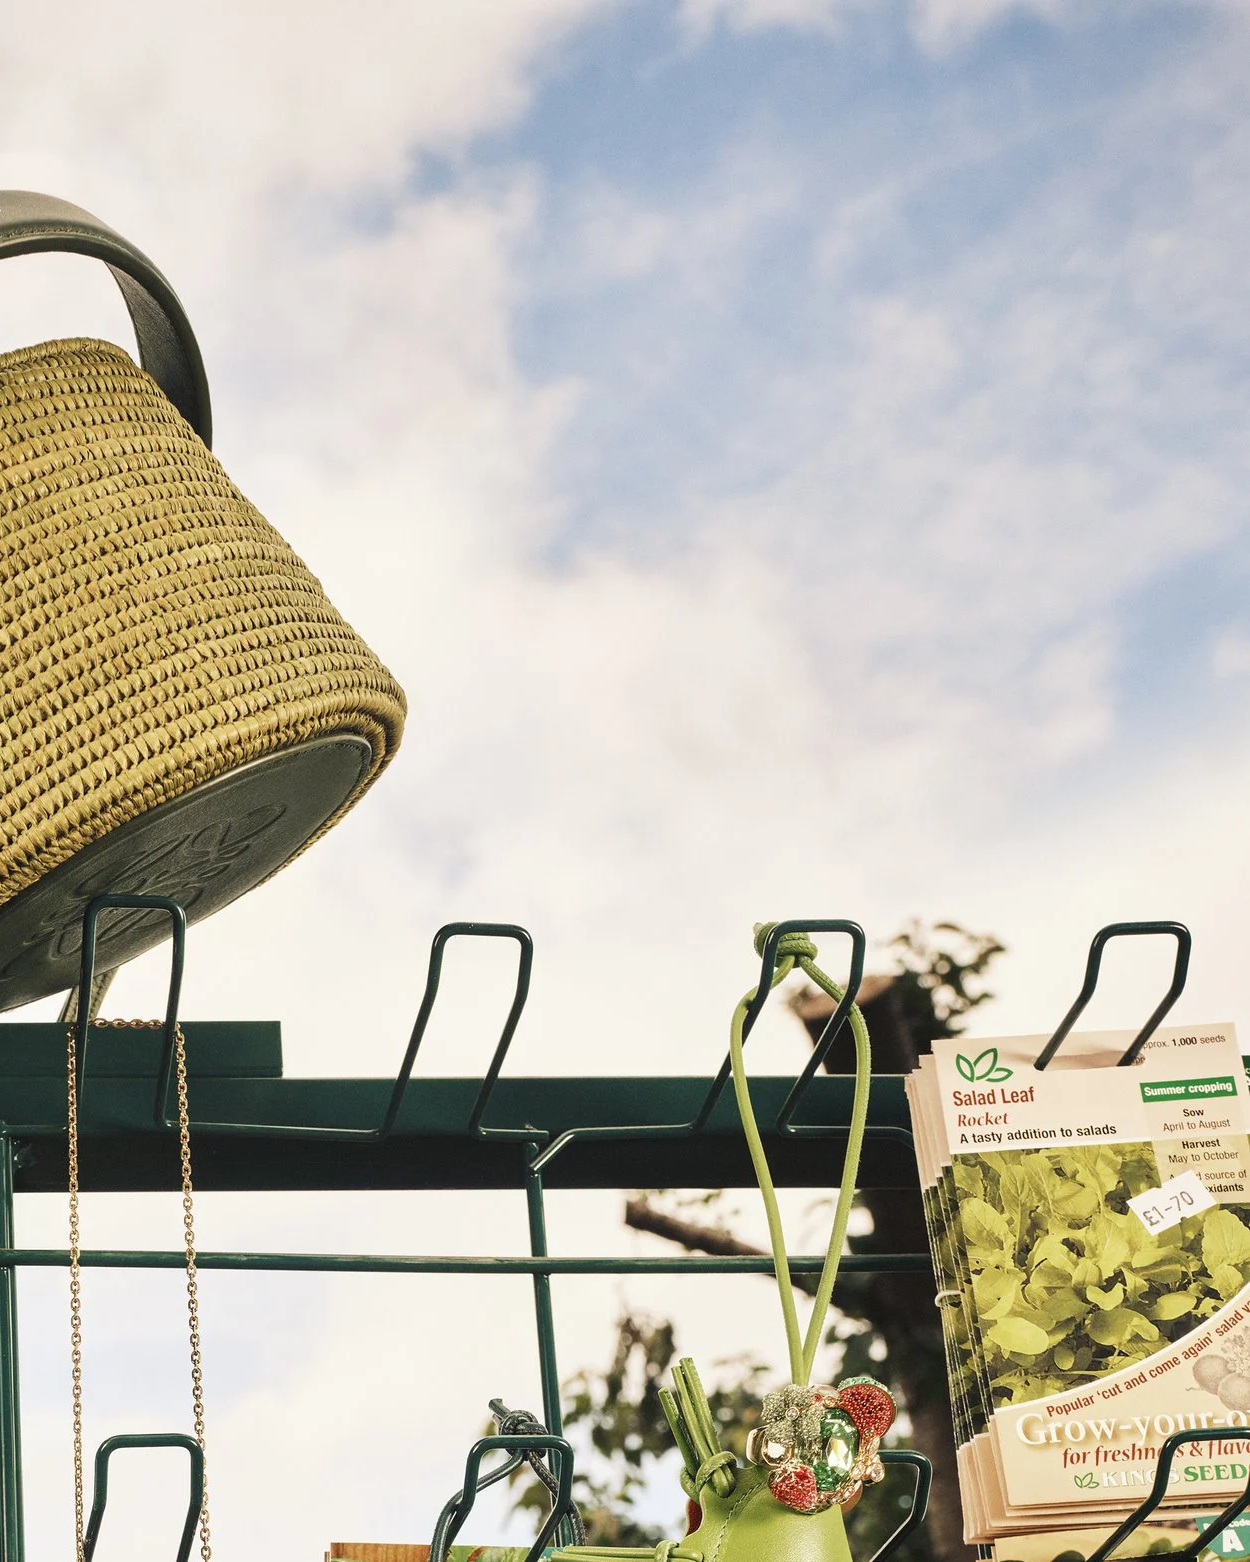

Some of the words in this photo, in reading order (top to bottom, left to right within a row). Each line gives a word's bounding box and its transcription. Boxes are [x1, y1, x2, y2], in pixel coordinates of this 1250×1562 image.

[1172, 1036, 1197, 1047] 1,000
[1200, 1034, 1226, 1045] seeds
[952, 1089, 997, 1106] Salad
[1001, 1086, 1034, 1104] Leaf
[1144, 1083, 1186, 1096] Summer
[1188, 1081, 1233, 1094] cropping
[957, 1112, 1010, 1127] Rocket
[1183, 1108, 1204, 1117] Sow
[1198, 1119, 1230, 1130] August
[972, 1131, 1002, 1143] tasty
[1007, 1128, 1057, 1141] addition
[1060, 1127, 1073, 1138] to
[1076, 1124, 1117, 1137] salads
[1181, 1139, 1221, 1149] Harvest
[1203, 1151, 1239, 1161] October
[1205, 1171, 1235, 1180] source
[1143, 1190, 1194, 1226] £1-70
[1046, 1394, 1096, 1418] Popular
[1124, 1372, 1147, 1390] and
[1149, 1355, 1181, 1378] come
[1215, 1310, 1244, 1337] salad
[1063, 1448, 1092, 1468] for
